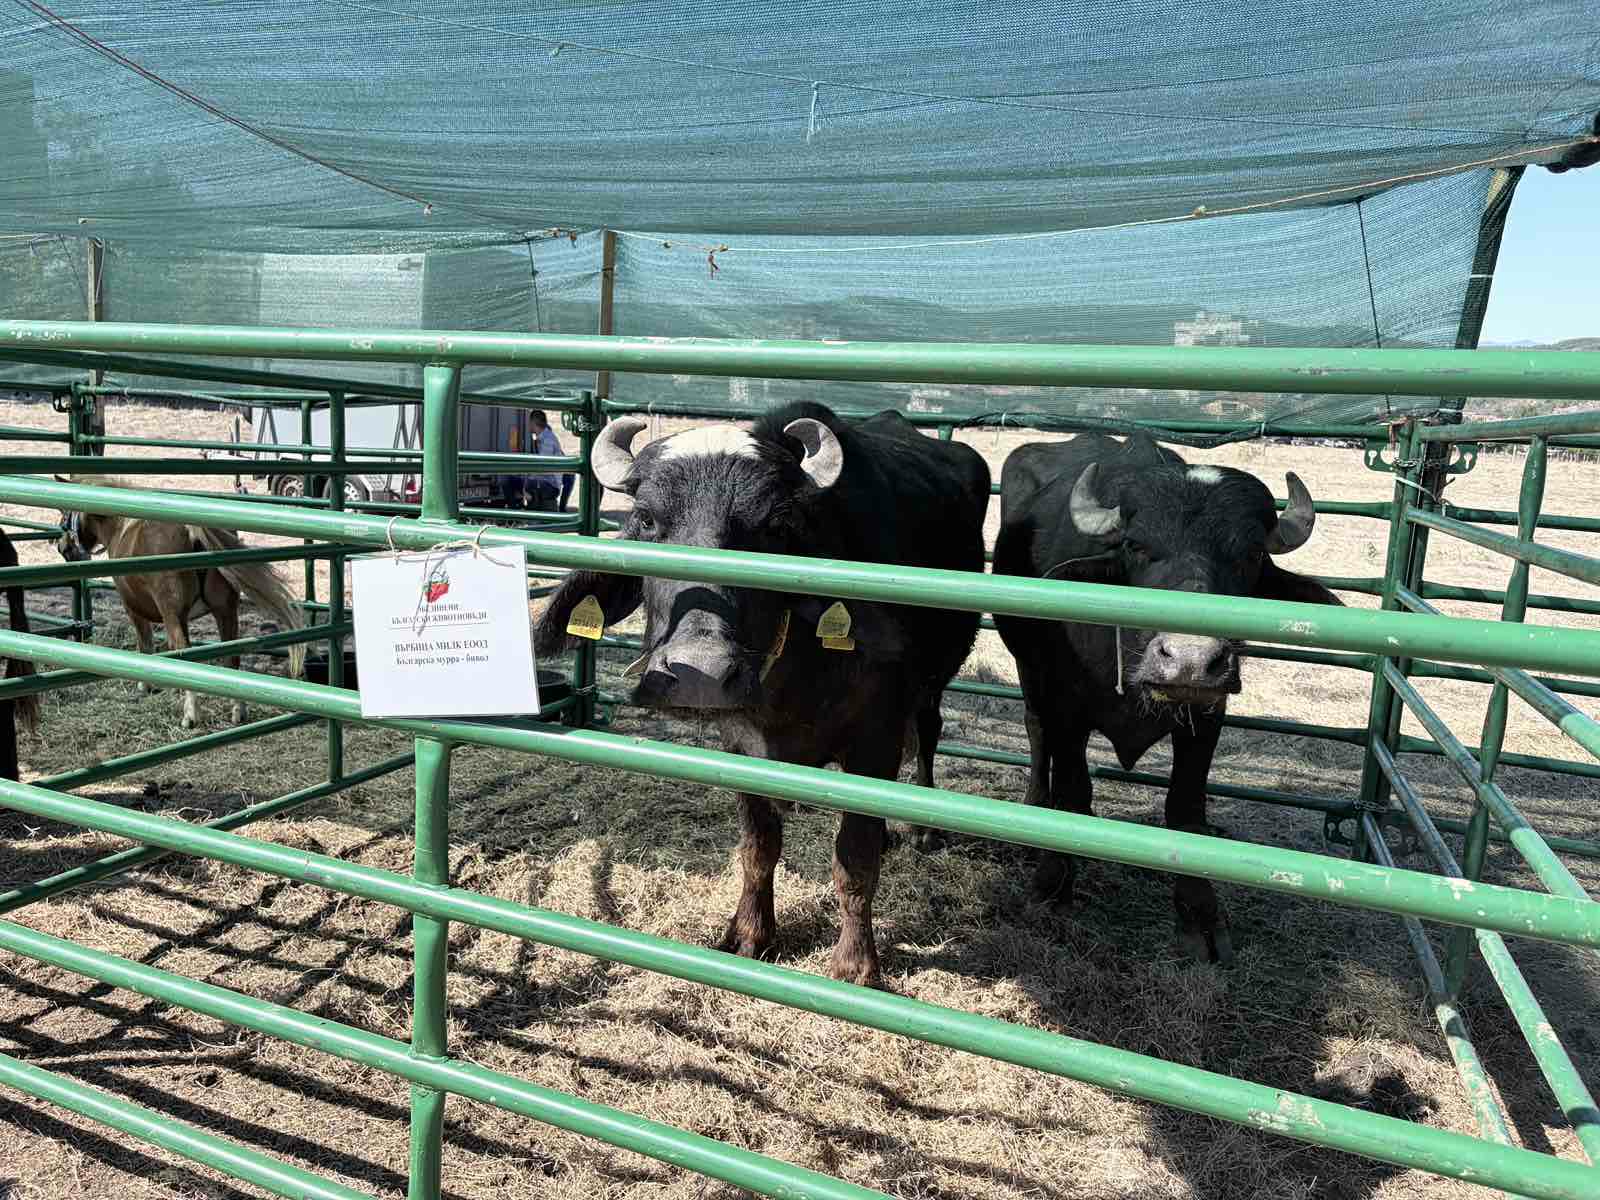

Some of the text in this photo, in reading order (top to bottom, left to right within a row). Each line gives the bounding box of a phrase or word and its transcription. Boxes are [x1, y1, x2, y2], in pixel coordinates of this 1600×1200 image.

[436, 640, 462, 650] МИЛК
[463, 639, 488, 649] ЕООД
[396, 656, 435, 667] Българска
[436, 656, 460, 666] мурра
[466, 653, 489, 662] бивол
